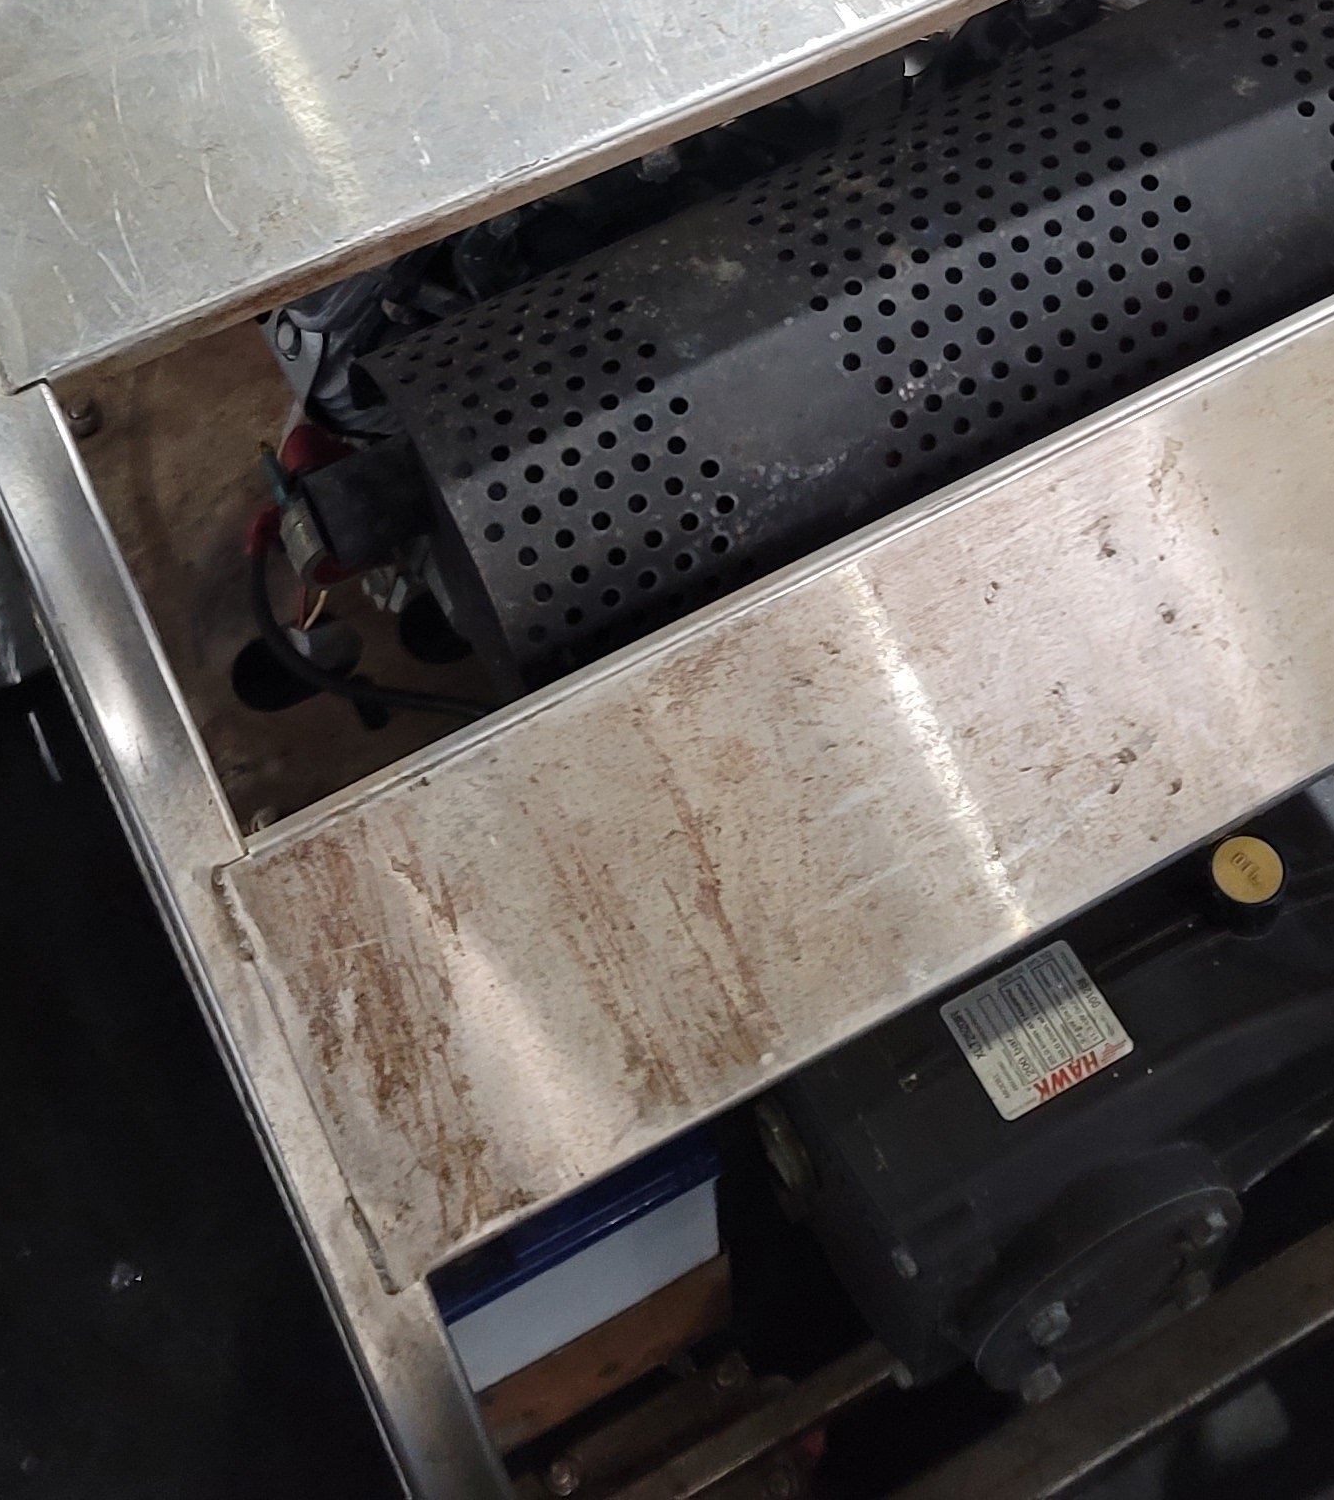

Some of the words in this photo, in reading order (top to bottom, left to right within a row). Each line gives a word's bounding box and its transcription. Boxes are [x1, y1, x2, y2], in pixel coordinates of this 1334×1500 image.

[1231, 851, 1260, 885] OIL
[1005, 1036, 1022, 1056] bar
[1017, 1055, 1035, 1077] 200
[1034, 1050, 1101, 1102] HAWK
